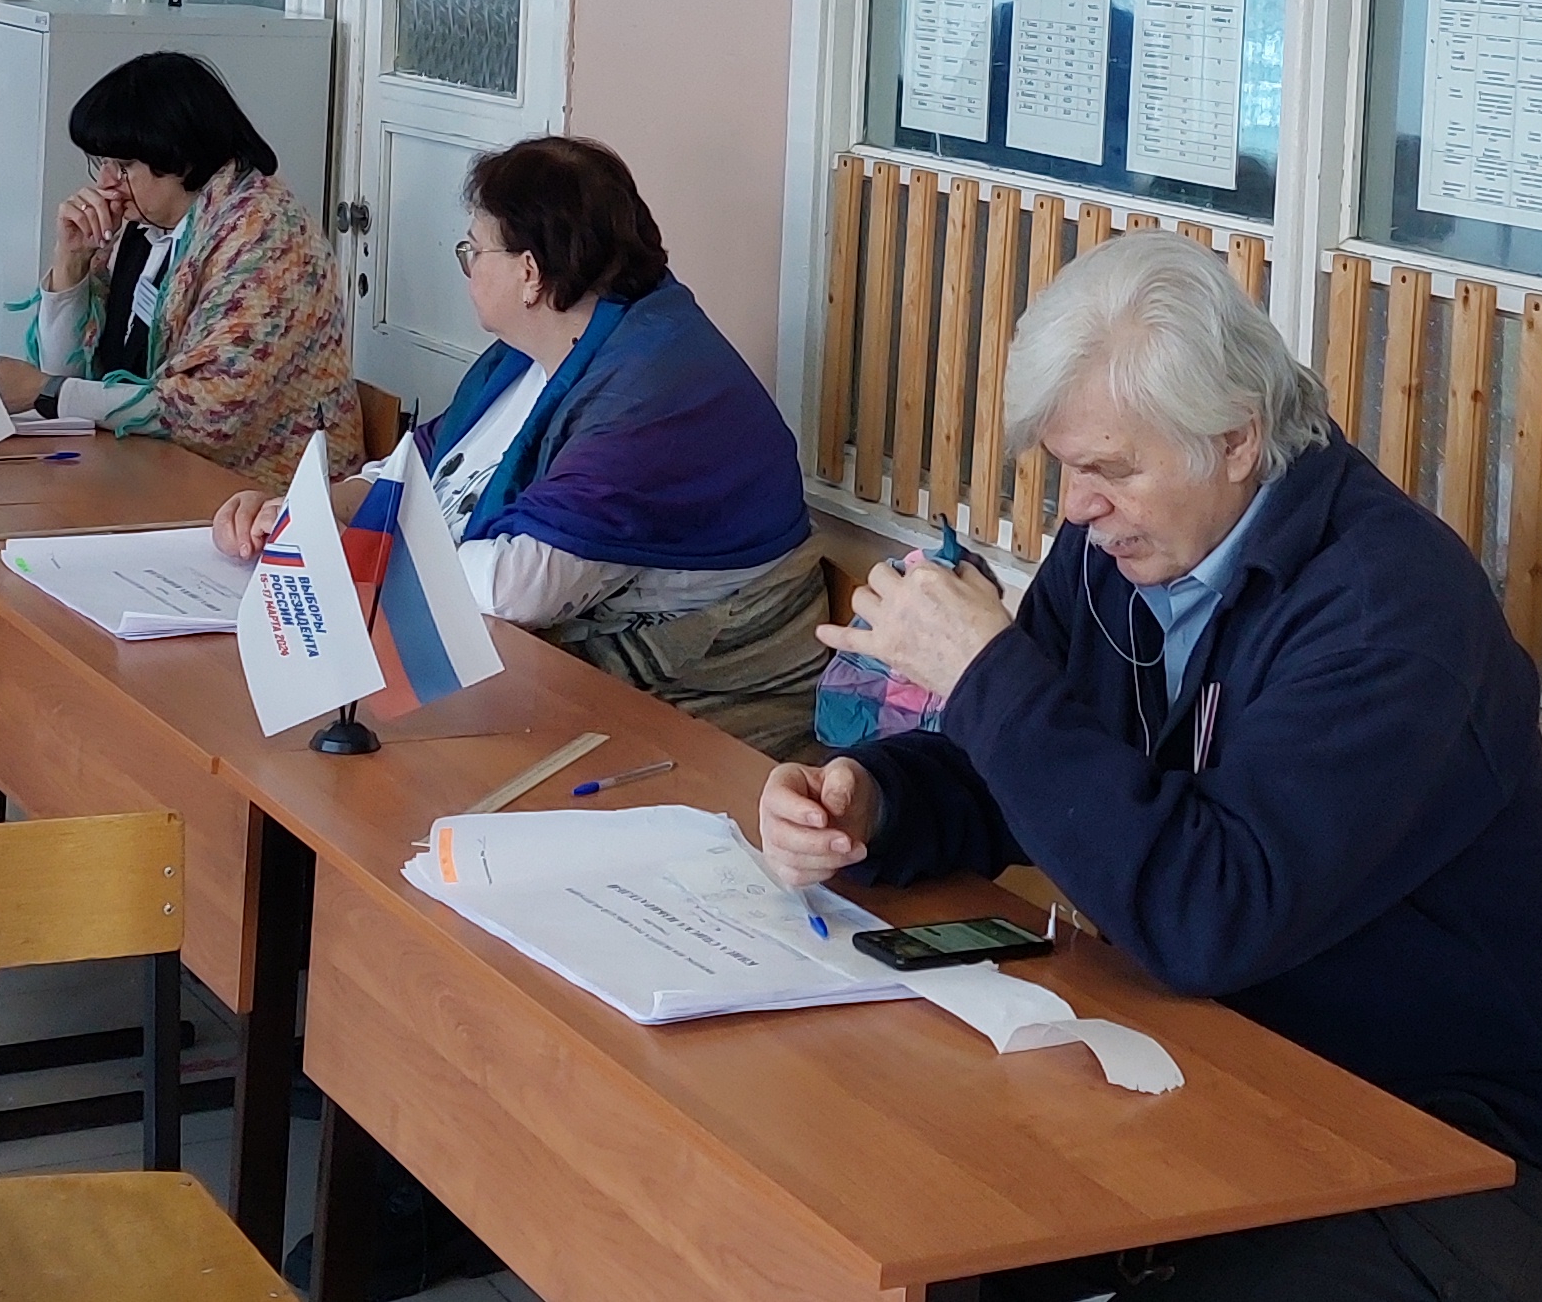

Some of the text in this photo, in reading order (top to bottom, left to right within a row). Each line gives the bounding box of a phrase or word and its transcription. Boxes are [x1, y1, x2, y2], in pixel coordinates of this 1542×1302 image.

[265, 600, 282, 633] МАРТА
[269, 573, 295, 626] РОССИИ
[282, 575, 320, 658] ПРЕЗИДЕНТА
[297, 576, 327, 634] ВЫБОРЫ
